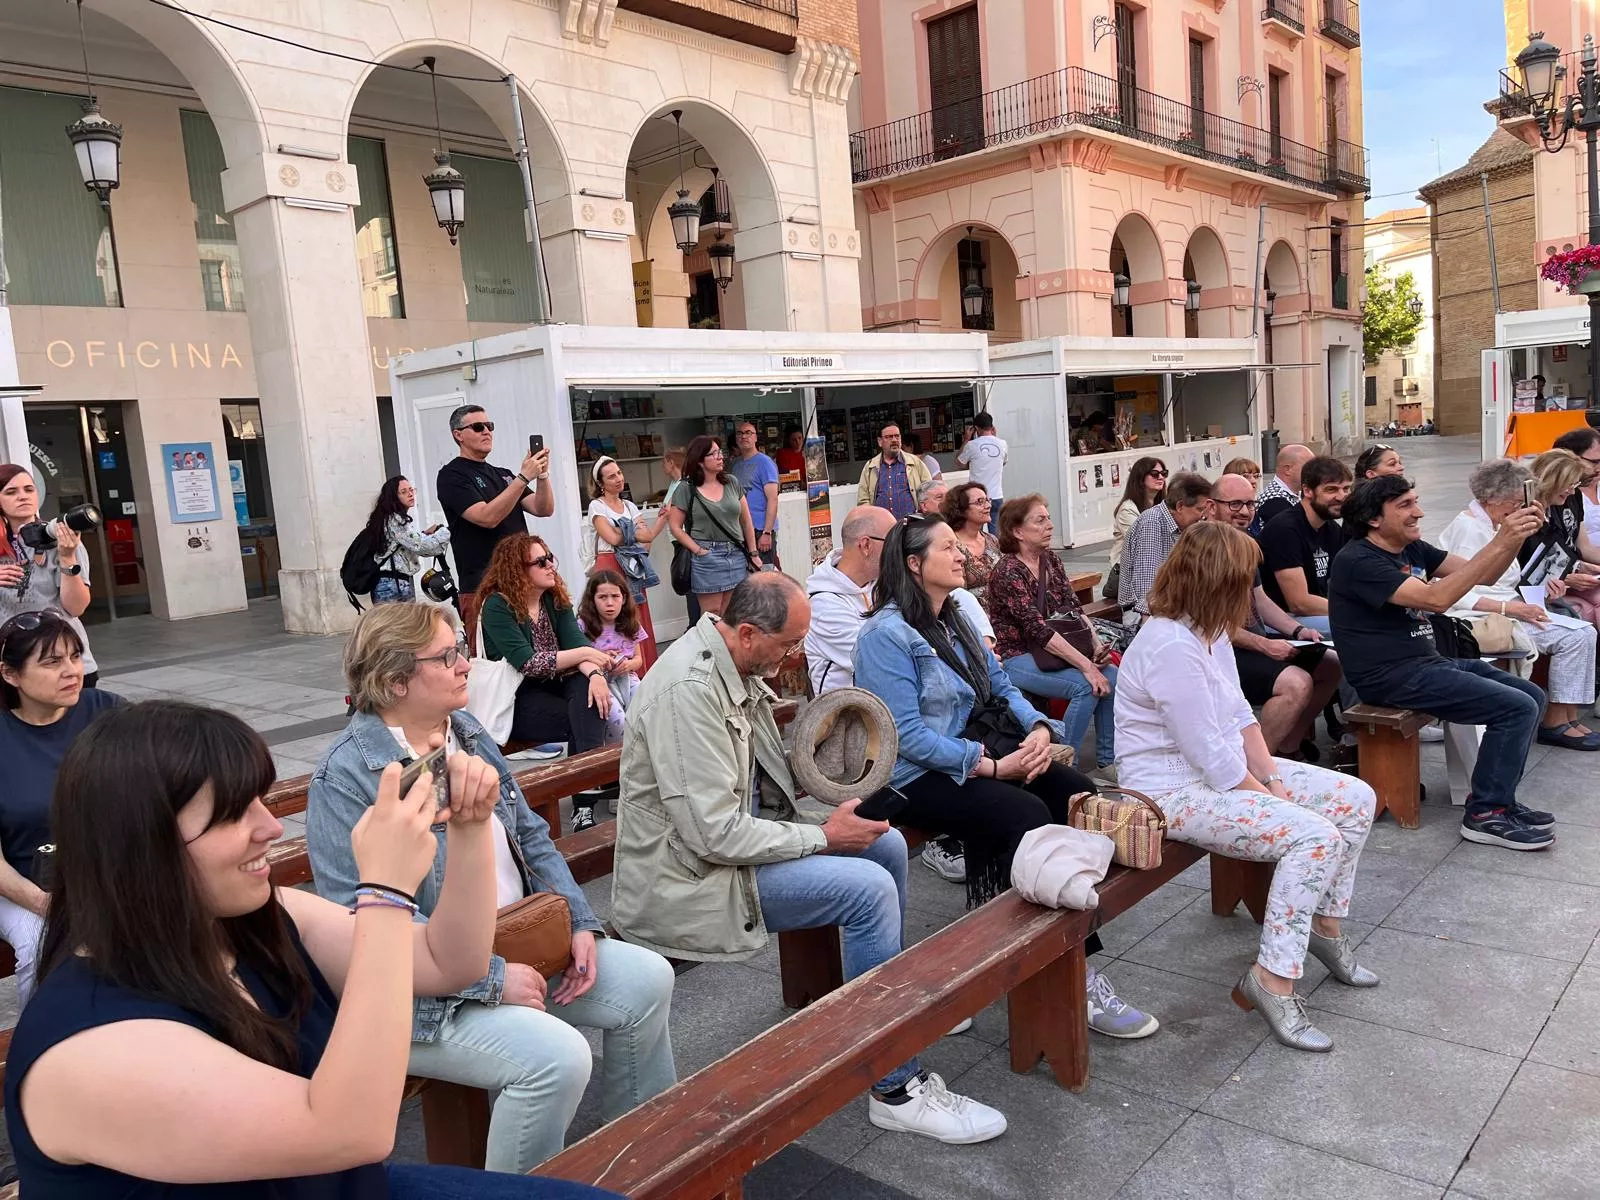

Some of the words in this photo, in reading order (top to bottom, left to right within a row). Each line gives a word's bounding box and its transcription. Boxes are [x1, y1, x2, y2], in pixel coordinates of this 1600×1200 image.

[475, 284, 515, 295] Naturaleza
[634, 280, 649, 288] ficina
[47, 340, 243, 369] OFICINA
[783, 357, 809, 367] Editorial
[811, 357, 832, 367] Pirineo
[29, 443, 59, 477] UESCA
